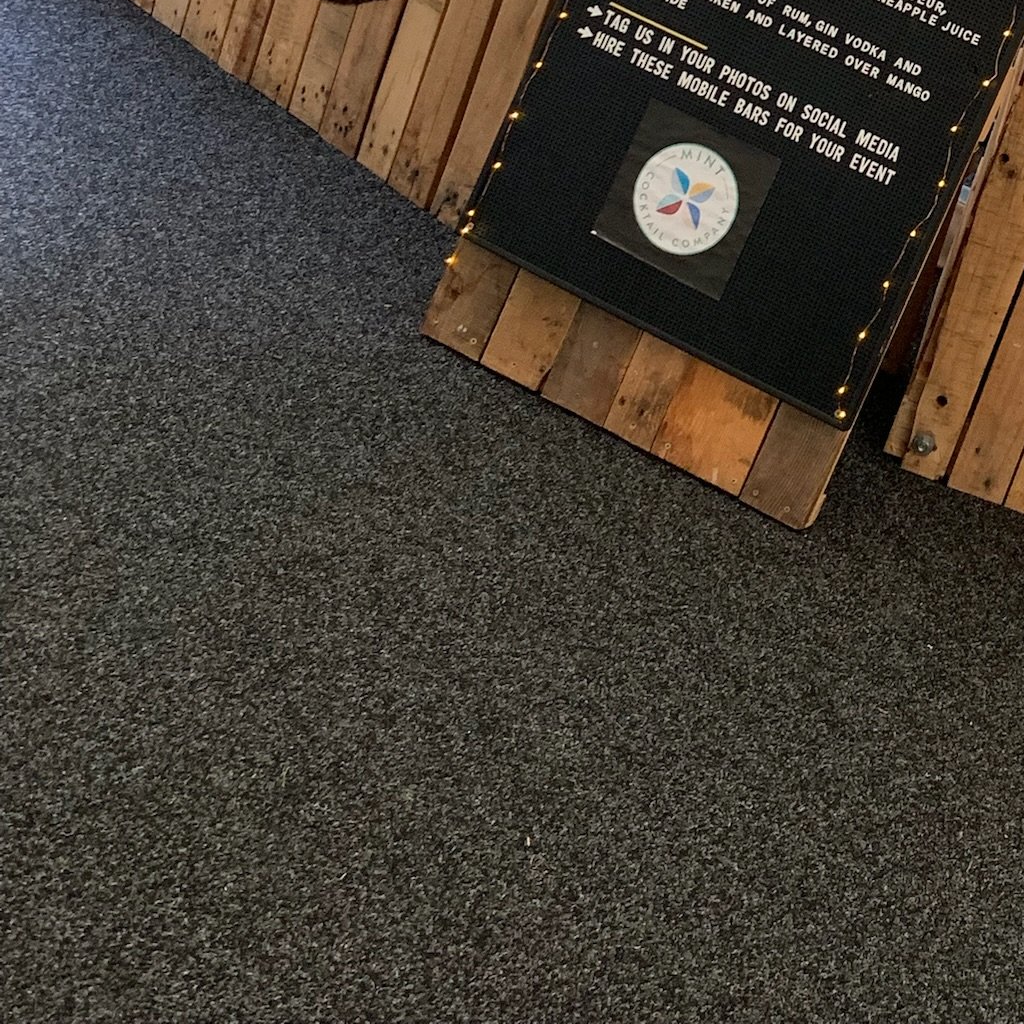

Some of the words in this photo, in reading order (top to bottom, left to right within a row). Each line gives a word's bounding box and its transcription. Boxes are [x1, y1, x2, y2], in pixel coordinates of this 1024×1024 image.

[745, 9, 772, 27] AND
[777, 23, 838, 58] LAYERED
[844, 54, 879, 79] OVER
[885, 73, 930, 101] MANGO
[781, 4, 811, 27] RUM,
[815, 19, 838, 37] GIN
[844, 32, 886, 61] VODKA
[893, 56, 921, 75] AND
[941, 21, 981, 45] JUICE
[592, 30, 625, 57] HIRE
[629, 47, 673, 79] THESE
[676, 70, 730, 107] MOBILE
[733, 97, 770, 125] BARS
[774, 117, 803, 142] FOR
[808, 132, 845, 162] YOUR
[848, 152, 896, 185] EVENT
[603, 9, 630, 33] TAG
[634, 24, 654, 44] US
[657, 35, 675, 54] IN
[679, 45, 715, 73] YOUR
[718, 64, 772, 100] PHOTOS
[776, 92, 797, 112] ON
[800, 103, 846, 138] SOCIAL
[854, 128, 899, 162] MEDIA
[680, 149, 726, 176] MINT
[638, 171, 665, 241] COCKTAIL
[671, 207, 730, 248] COMPANY
